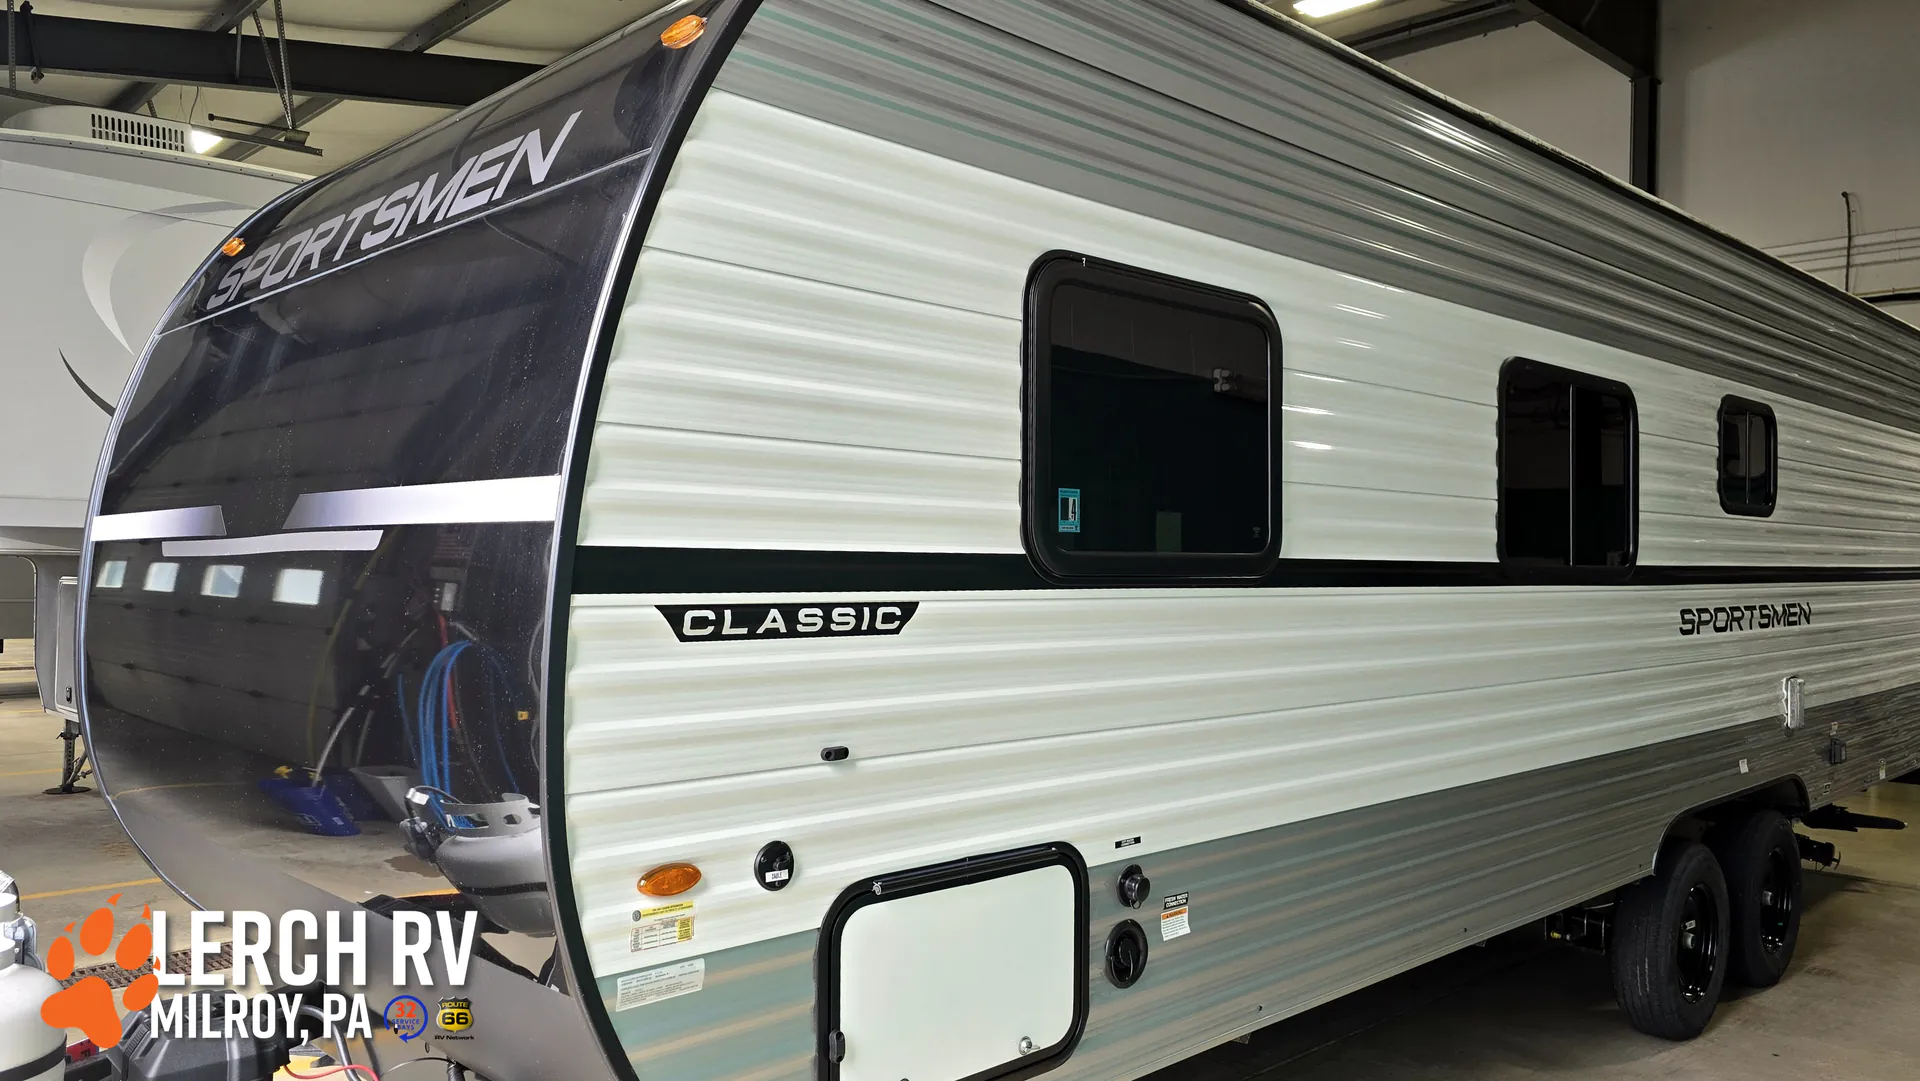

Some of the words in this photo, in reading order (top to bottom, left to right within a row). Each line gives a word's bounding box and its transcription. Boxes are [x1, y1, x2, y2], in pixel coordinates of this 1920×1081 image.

[206, 110, 583, 310] SPORTSMEN
[682, 606, 902, 636] CLASSIC
[1679, 602, 1812, 636] SPORTSMEN
